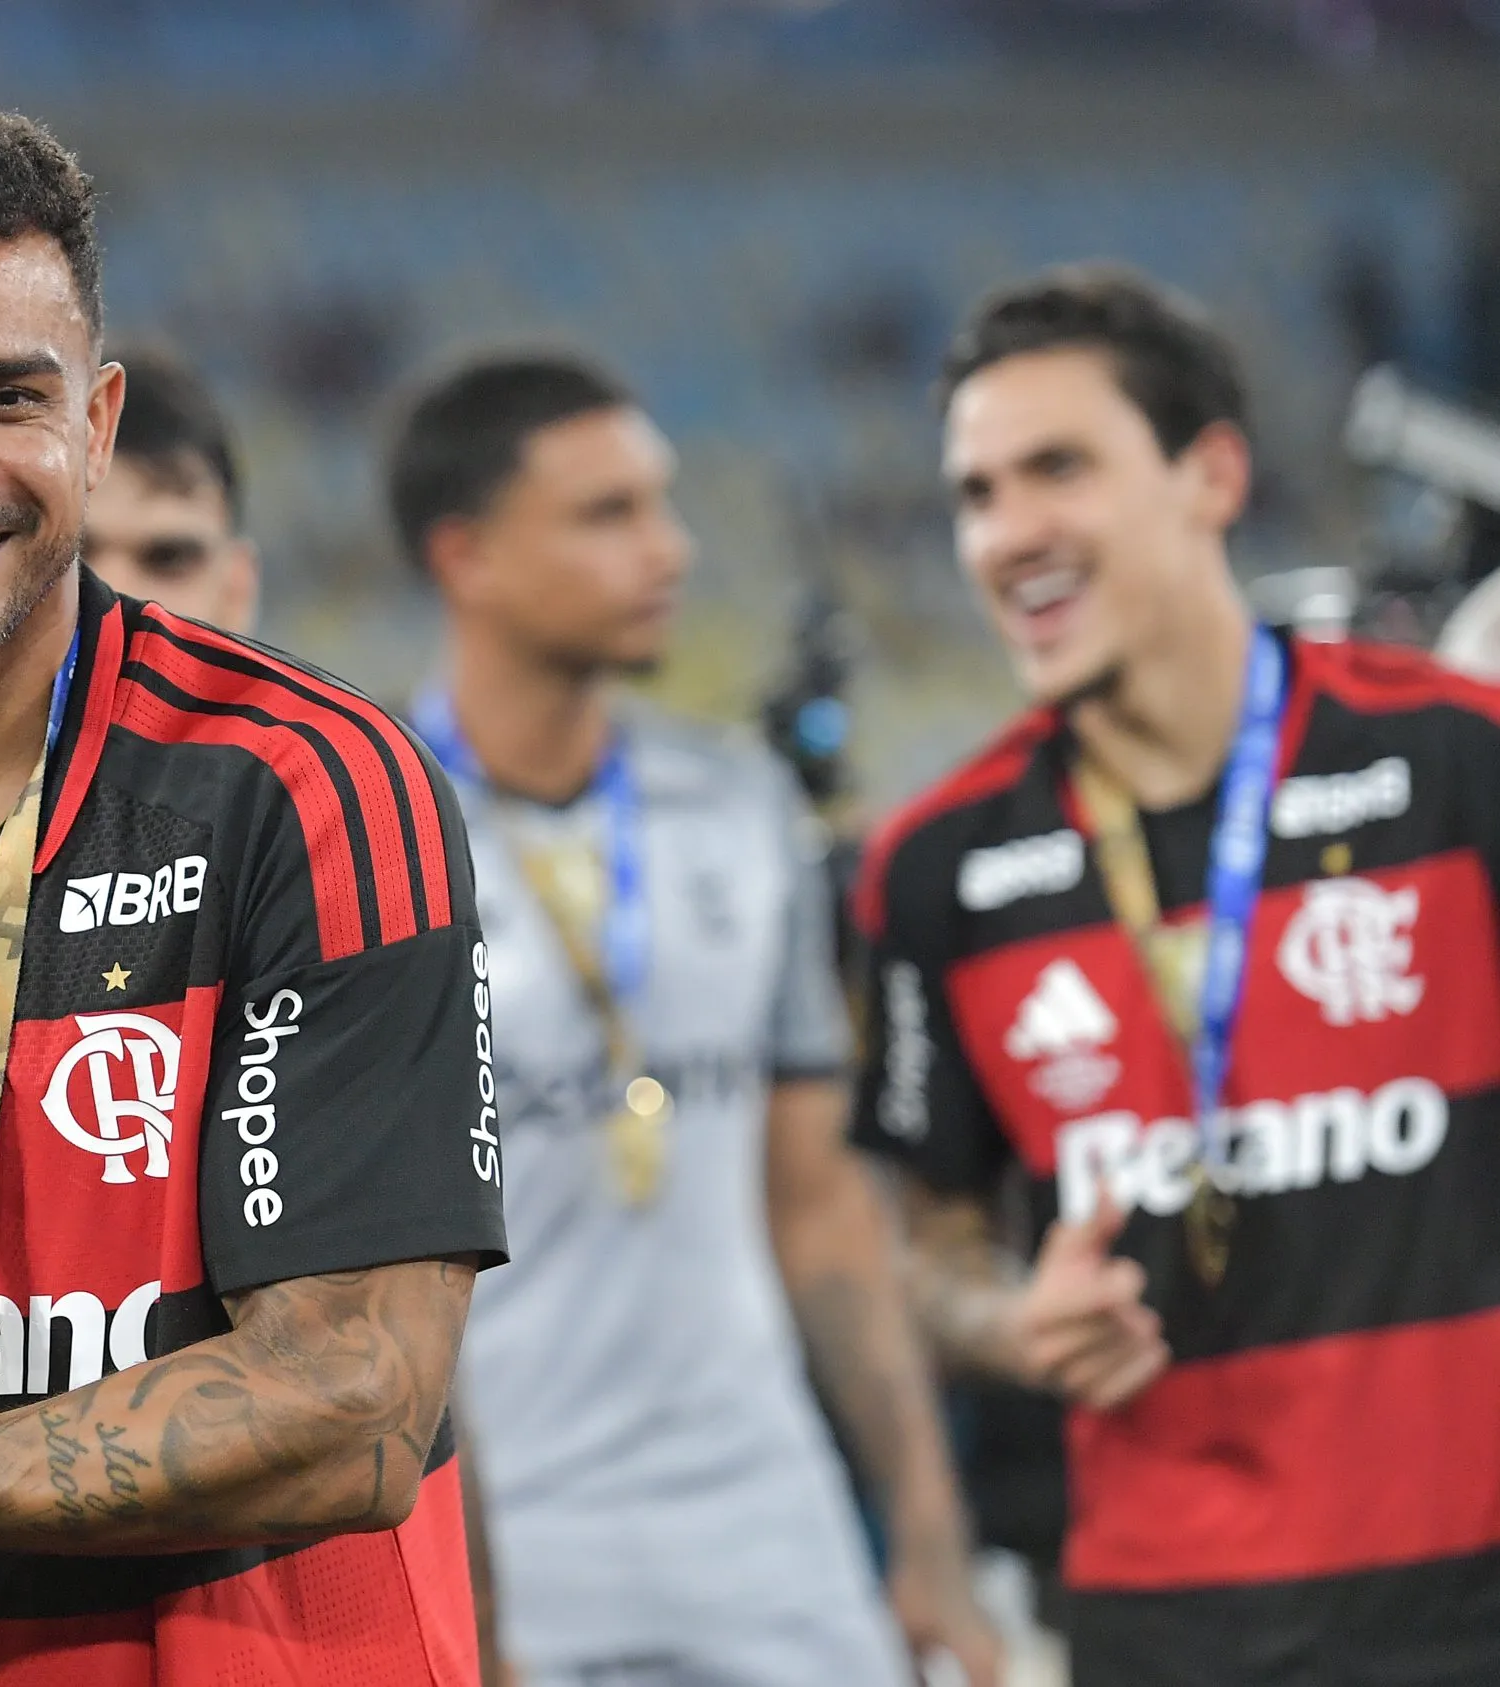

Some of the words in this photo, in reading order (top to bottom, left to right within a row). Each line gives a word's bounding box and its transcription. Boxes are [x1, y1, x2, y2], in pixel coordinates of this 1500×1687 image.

[108, 855, 207, 927] BRB
[221, 988, 303, 1228] Shopee
[469, 941, 500, 1189] Shopee
